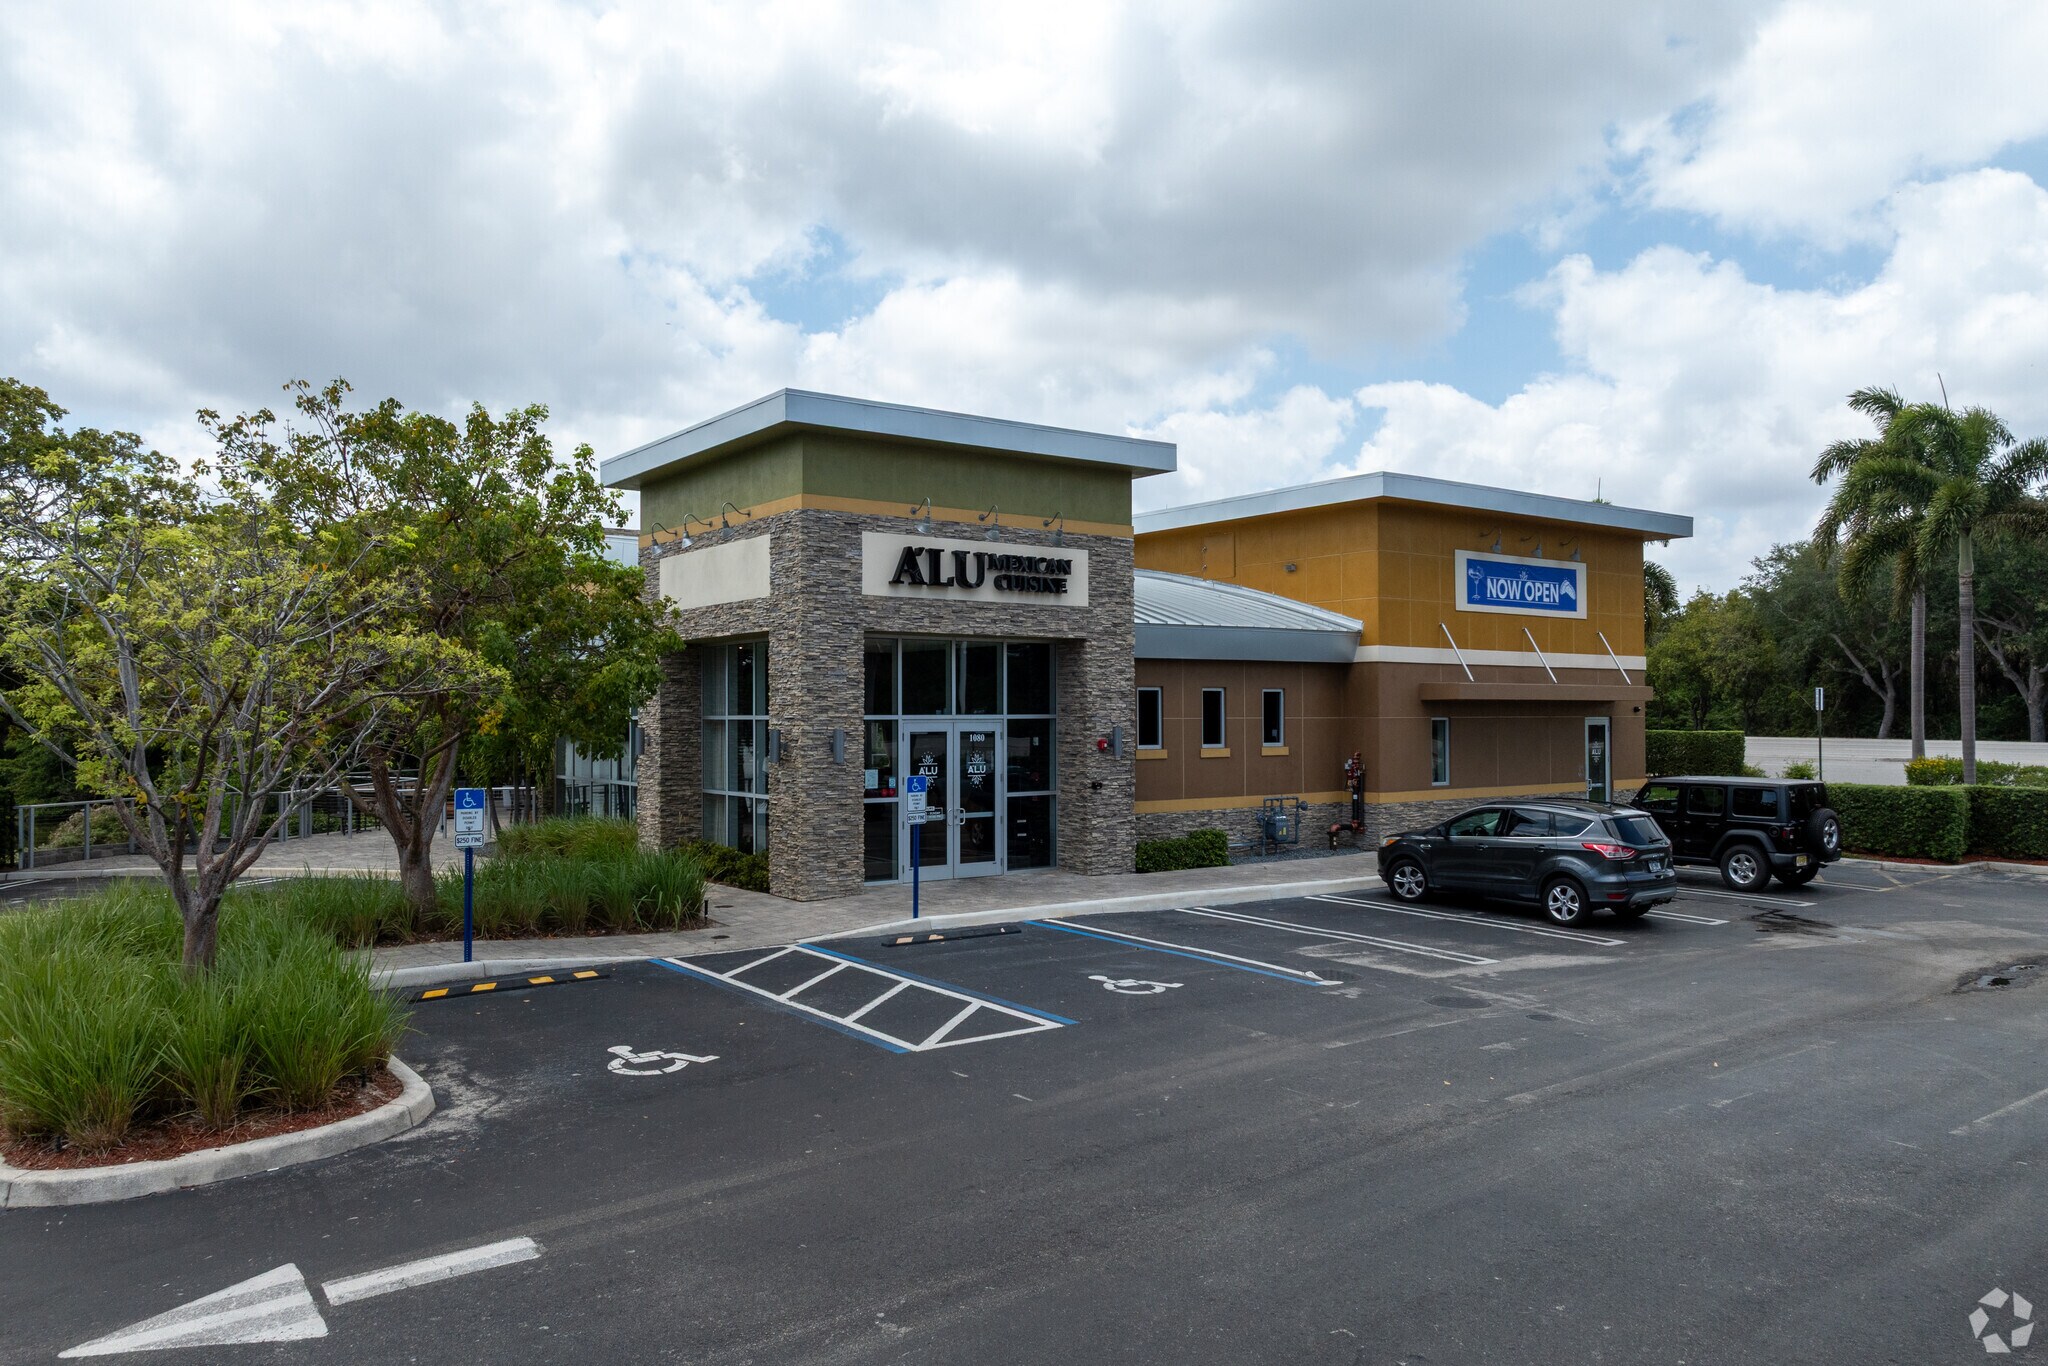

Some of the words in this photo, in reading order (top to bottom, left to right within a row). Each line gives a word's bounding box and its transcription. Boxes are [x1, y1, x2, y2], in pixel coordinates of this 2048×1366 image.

[987, 553, 1073, 575] MEXICAN
[993, 573, 1068, 594] CUISINE
[1486, 577, 1522, 600] NOW
[1524, 581, 1559, 603] OPEN
[969, 733, 985, 742] 1080
